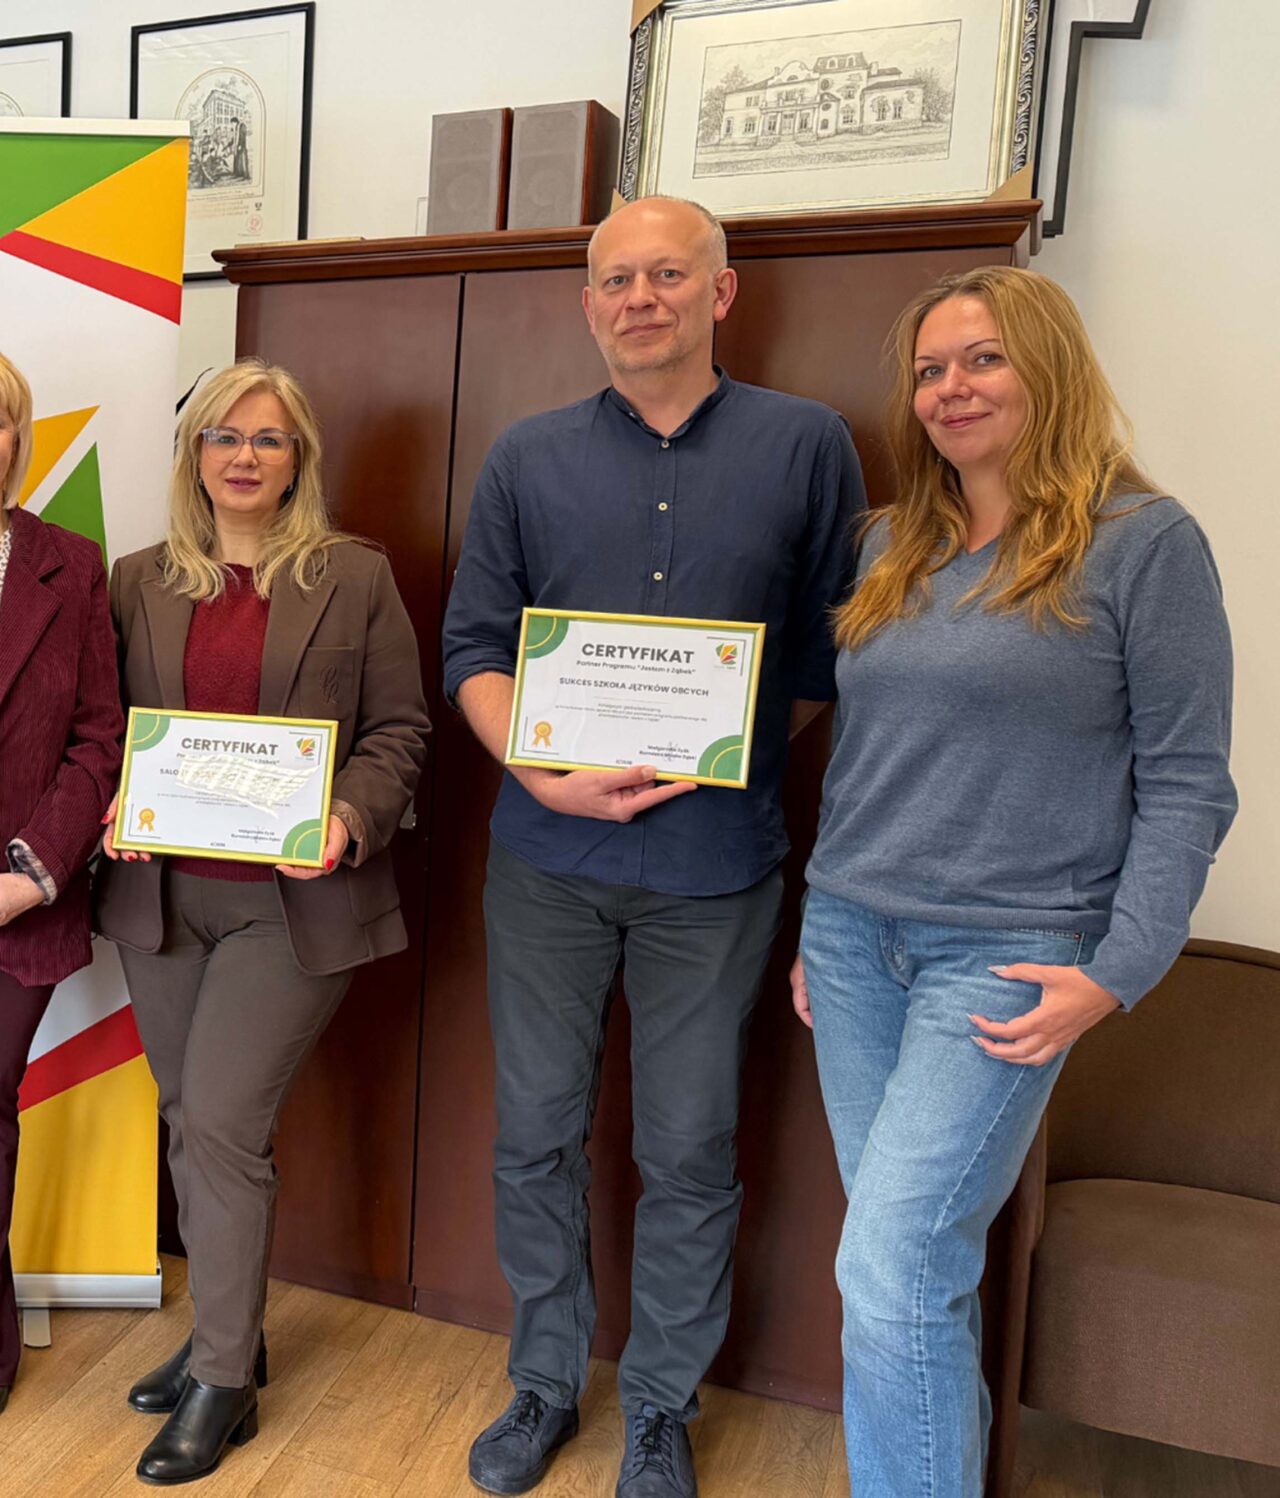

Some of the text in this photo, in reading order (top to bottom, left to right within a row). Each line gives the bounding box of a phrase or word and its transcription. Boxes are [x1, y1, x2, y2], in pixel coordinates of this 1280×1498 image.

[581, 643, 695, 664] CERTYFIKAT
[602, 662, 636, 670] Programu
[559, 677, 709, 697] SUKCES SZKOŁA JĘZYKÓW OBCYCH
[181, 737, 279, 756] CERTYFIKAT
